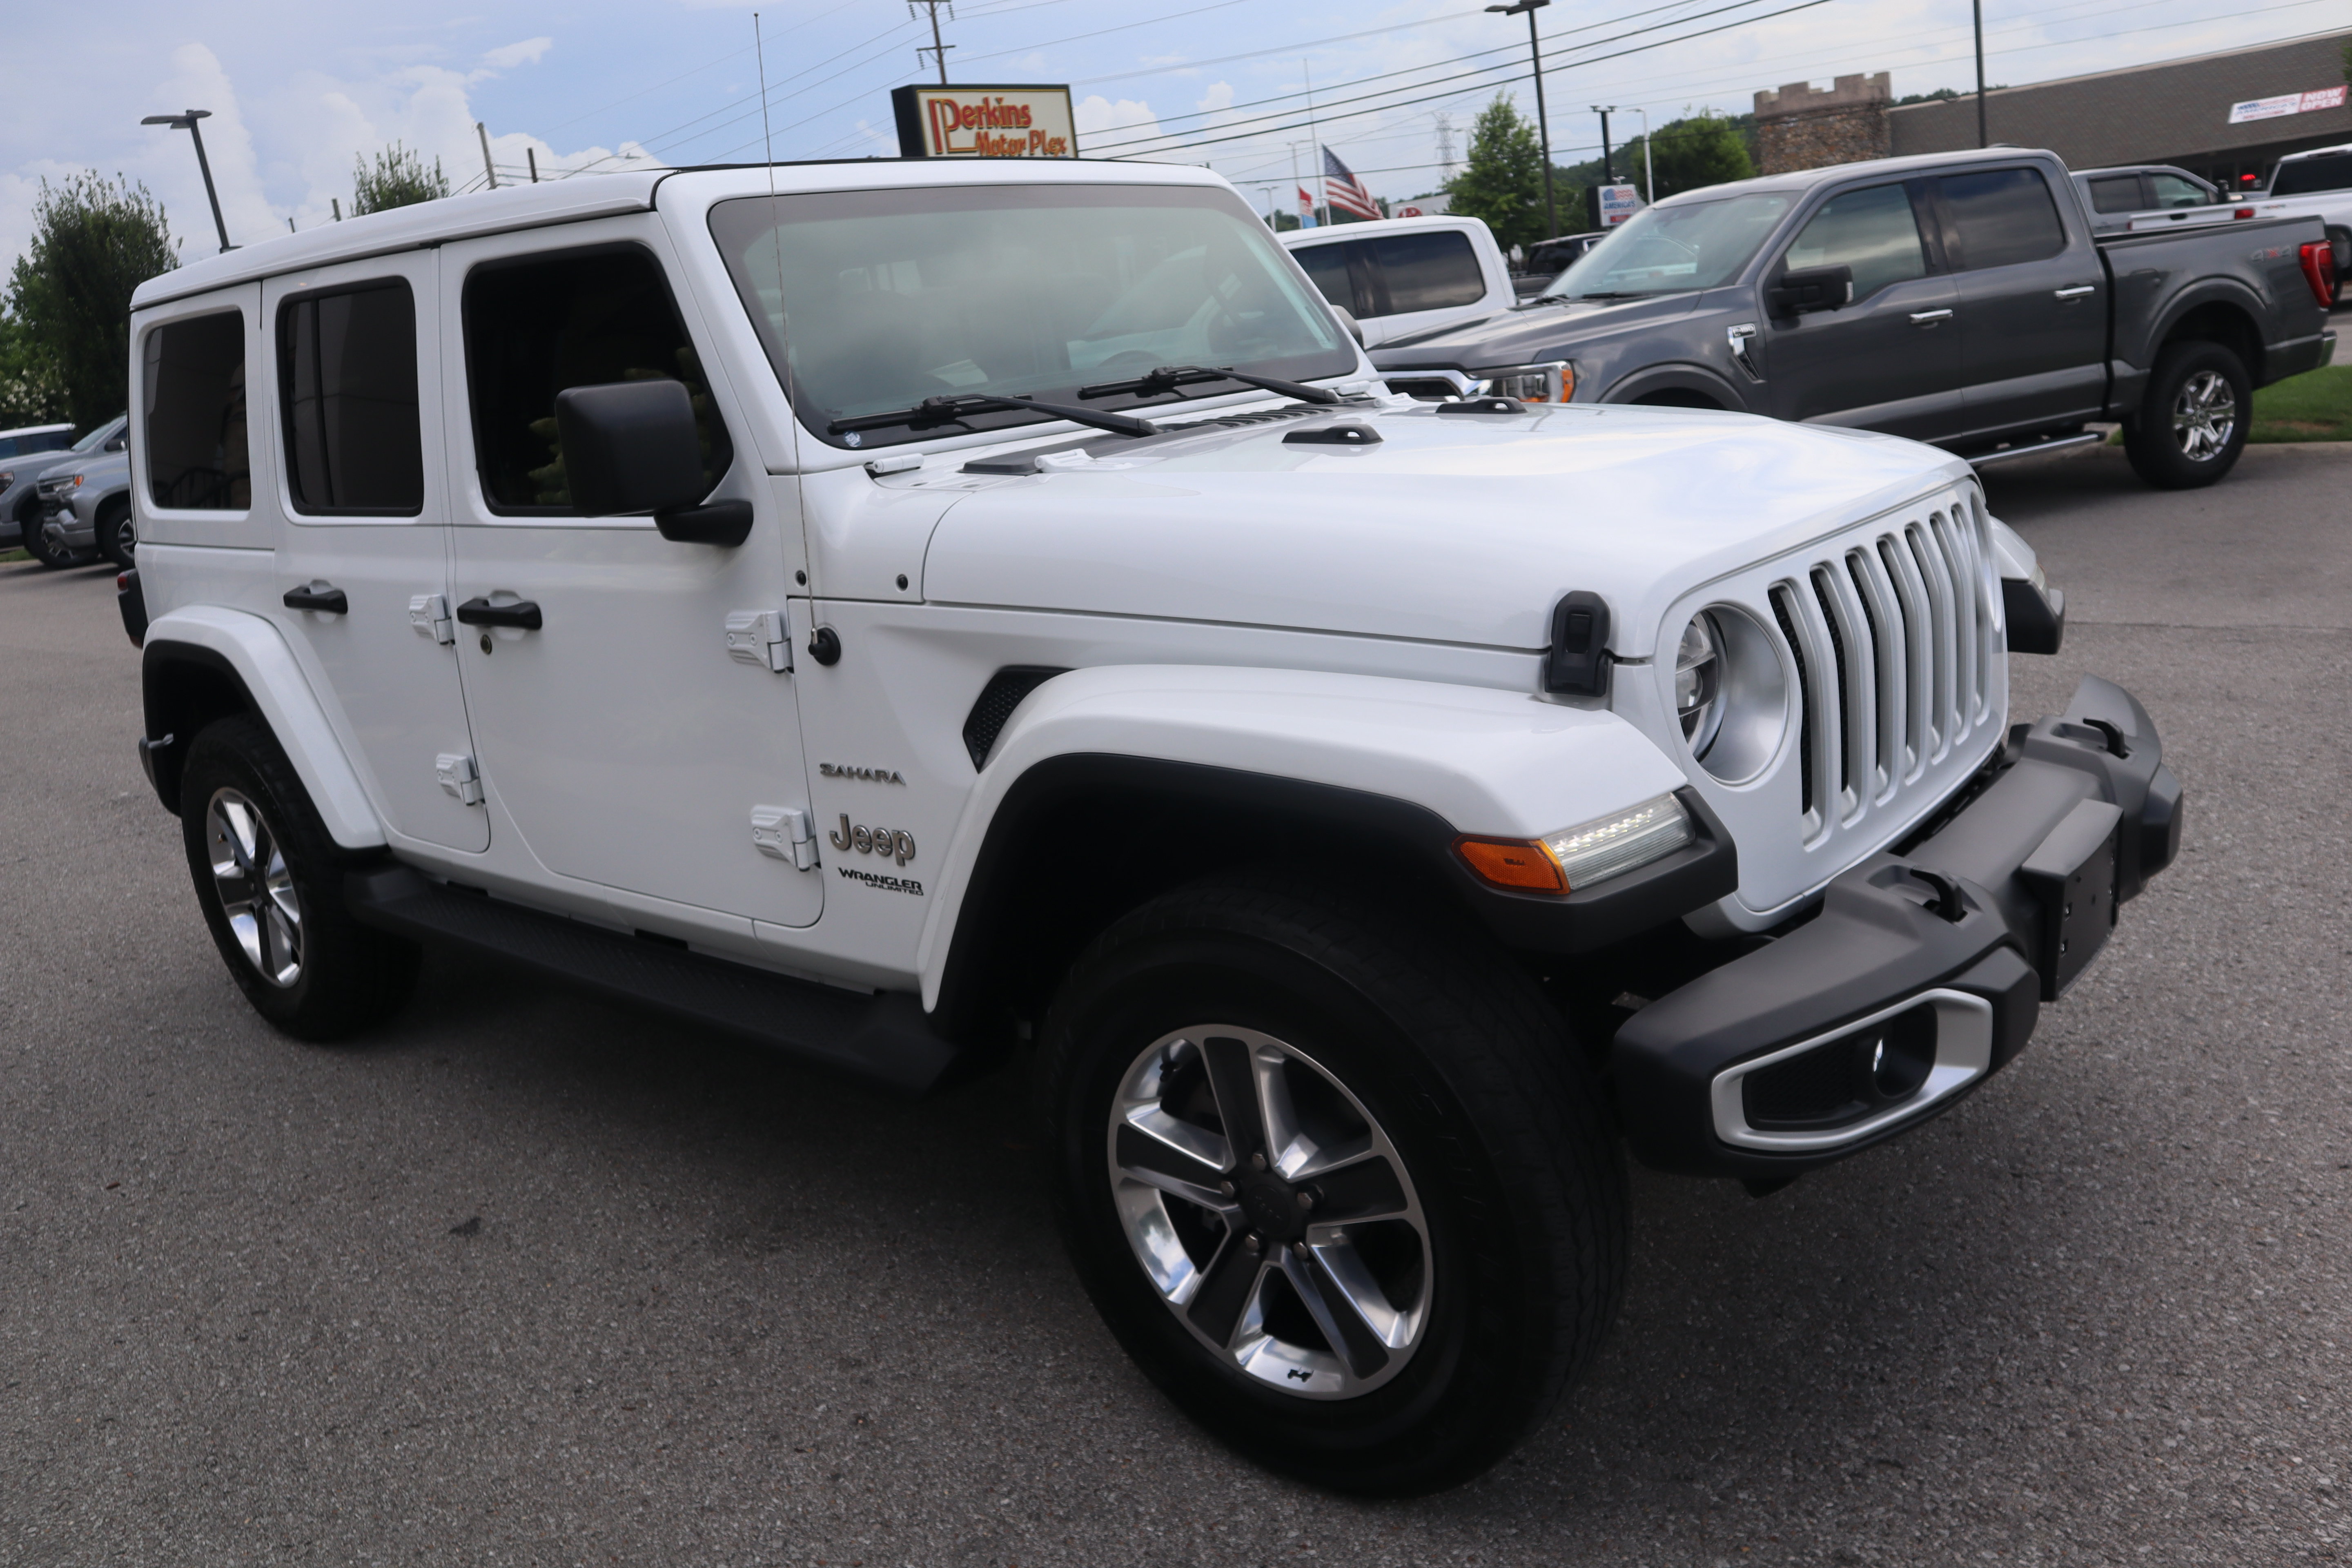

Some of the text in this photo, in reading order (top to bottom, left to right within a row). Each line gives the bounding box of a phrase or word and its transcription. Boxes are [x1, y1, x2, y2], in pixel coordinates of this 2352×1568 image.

[2301, 96, 2343, 110] OPEN
[2306, 88, 2343, 101] NOW
[928, 96, 1032, 154] Perkins
[976, 129, 1067, 157] Motor Plex
[819, 762, 906, 785] SAHARA
[829, 813, 915, 866] Jeep
[837, 867, 922, 891] WRANGLER
[865, 882, 924, 896] UNLIMITED
